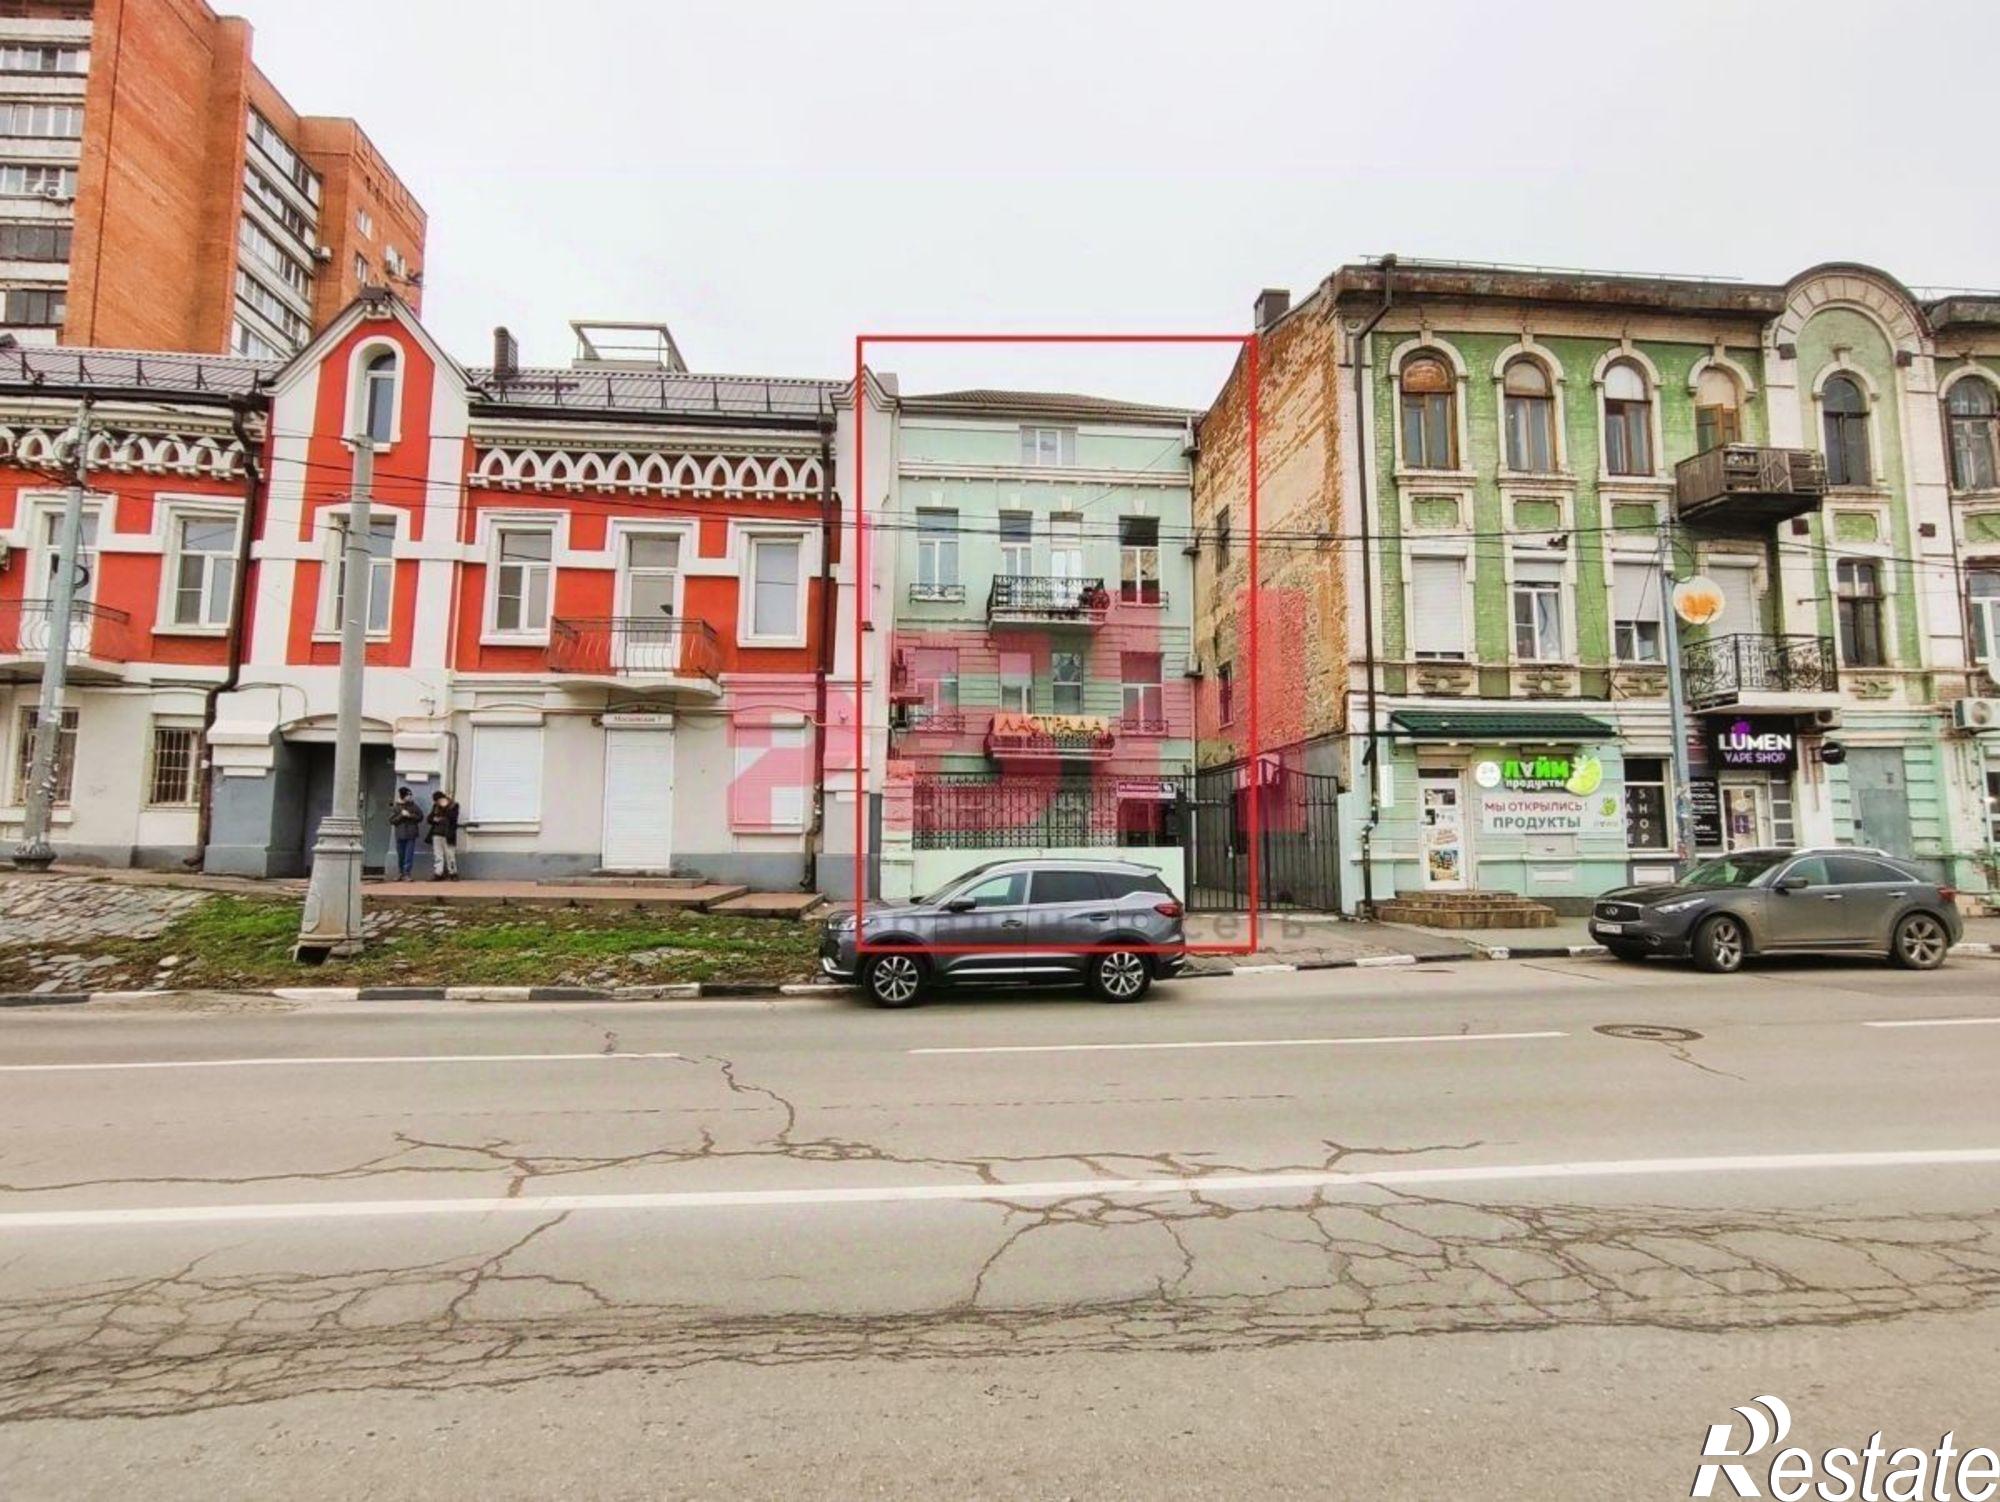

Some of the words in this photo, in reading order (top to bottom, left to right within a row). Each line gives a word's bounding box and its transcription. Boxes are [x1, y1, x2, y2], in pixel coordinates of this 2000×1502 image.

[1718, 733, 1792, 751] LUMEN
[1724, 752, 1752, 763] VAPE
[1755, 752, 1786, 763] SHOP
[1506, 779, 1565, 790] продукты
[1484, 802, 1506, 812] МЫ
[1638, 788, 1650, 845] SHOP
[1493, 816, 1581, 830] ПРОДУКТЫ
